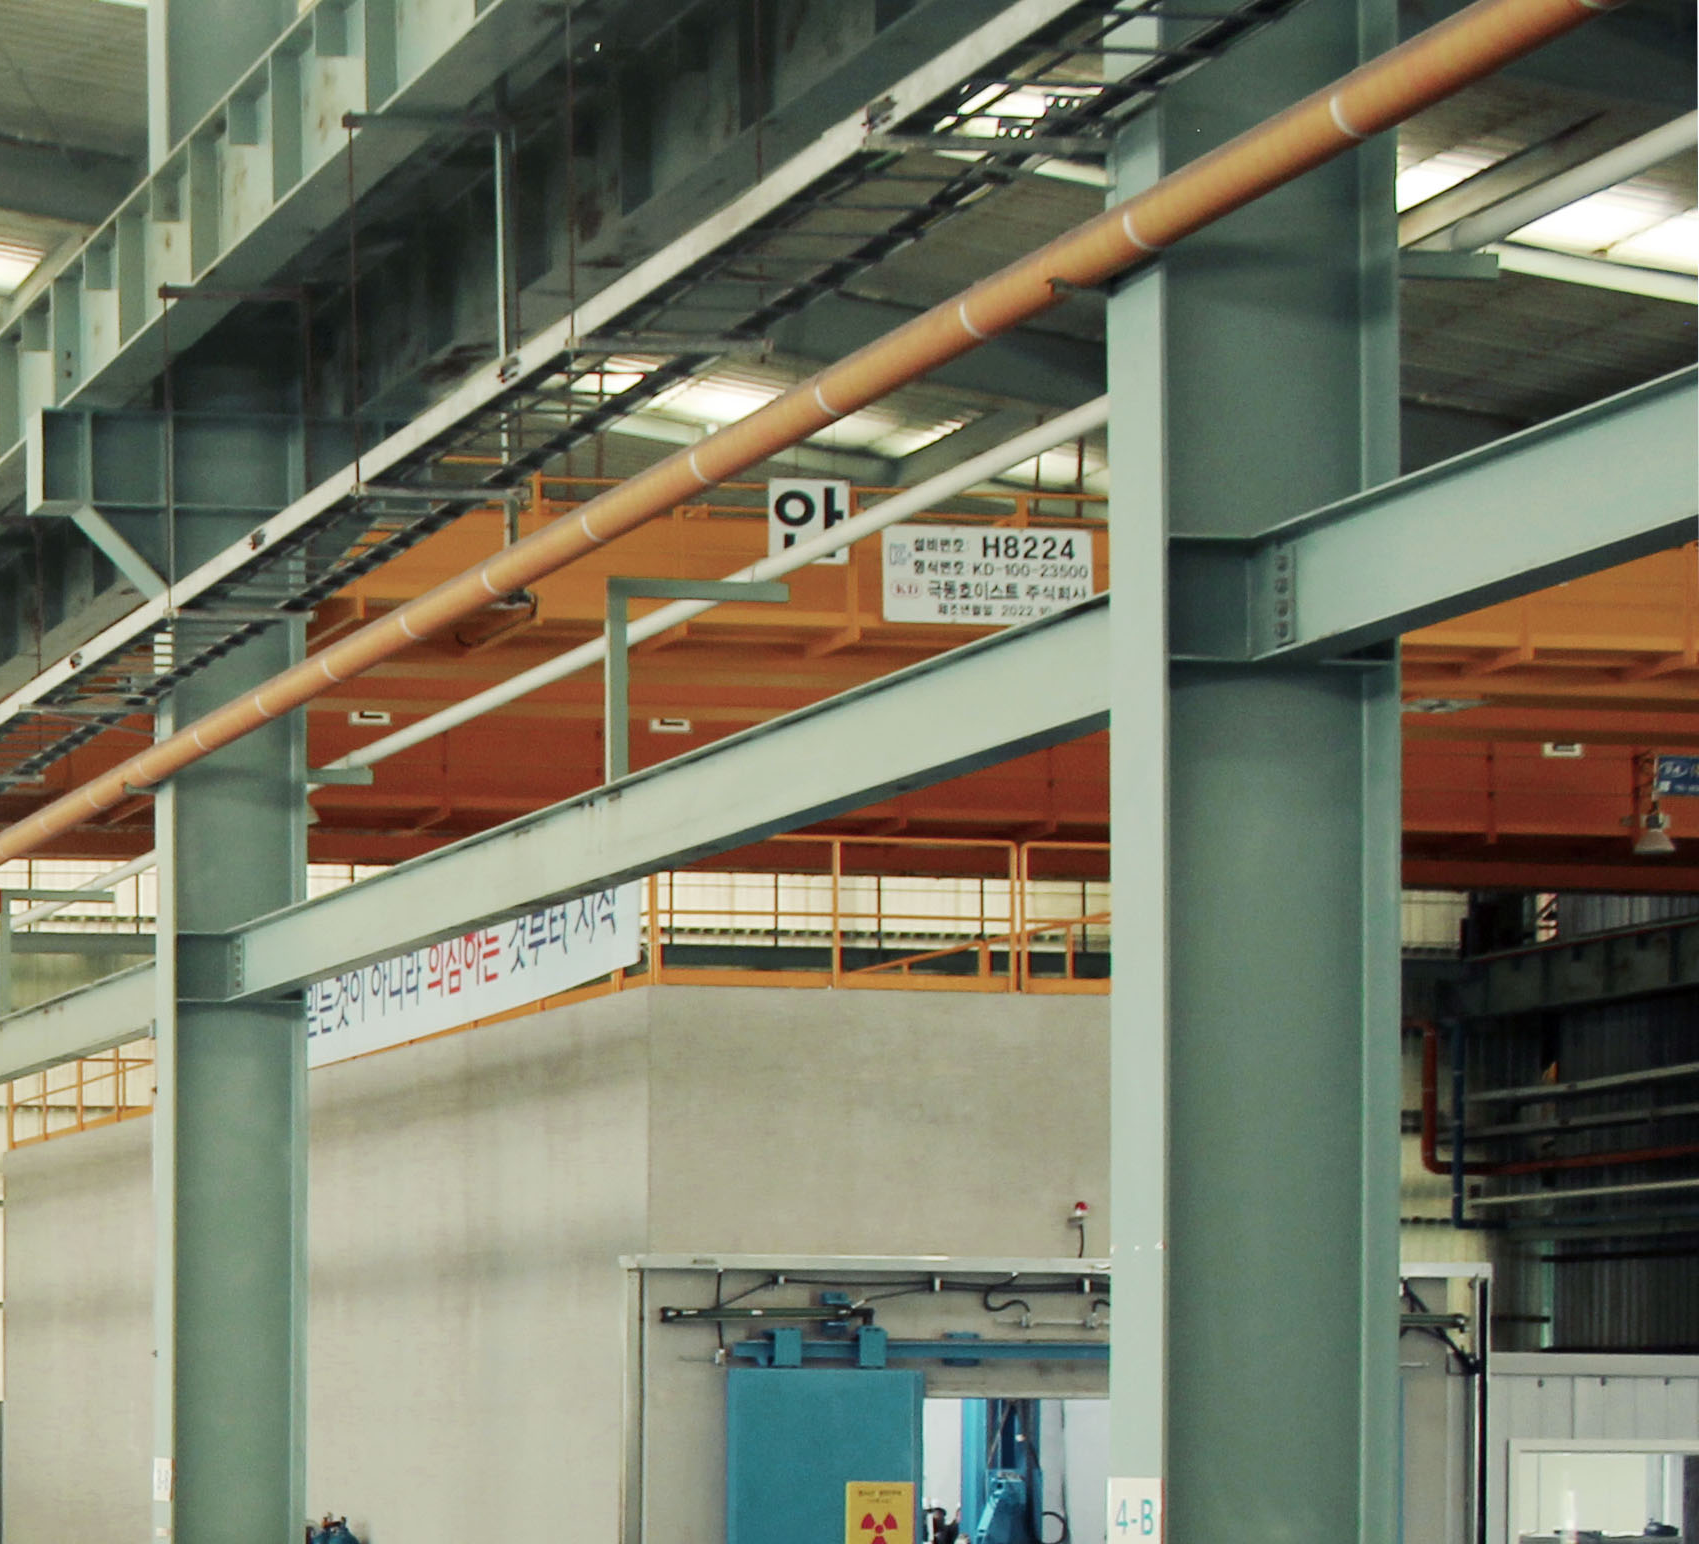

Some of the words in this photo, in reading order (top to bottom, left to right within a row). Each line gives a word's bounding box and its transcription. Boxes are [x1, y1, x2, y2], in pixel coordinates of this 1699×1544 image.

[774, 486, 844, 558] 안
[982, 536, 1076, 560] H8224
[370, 950, 422, 1016] 아니라
[427, 932, 501, 998] 의심하는
[508, 907, 568, 974] 것부터
[574, 886, 617, 944] 시작
[1114, 1498, 1155, 1536] 4-B
